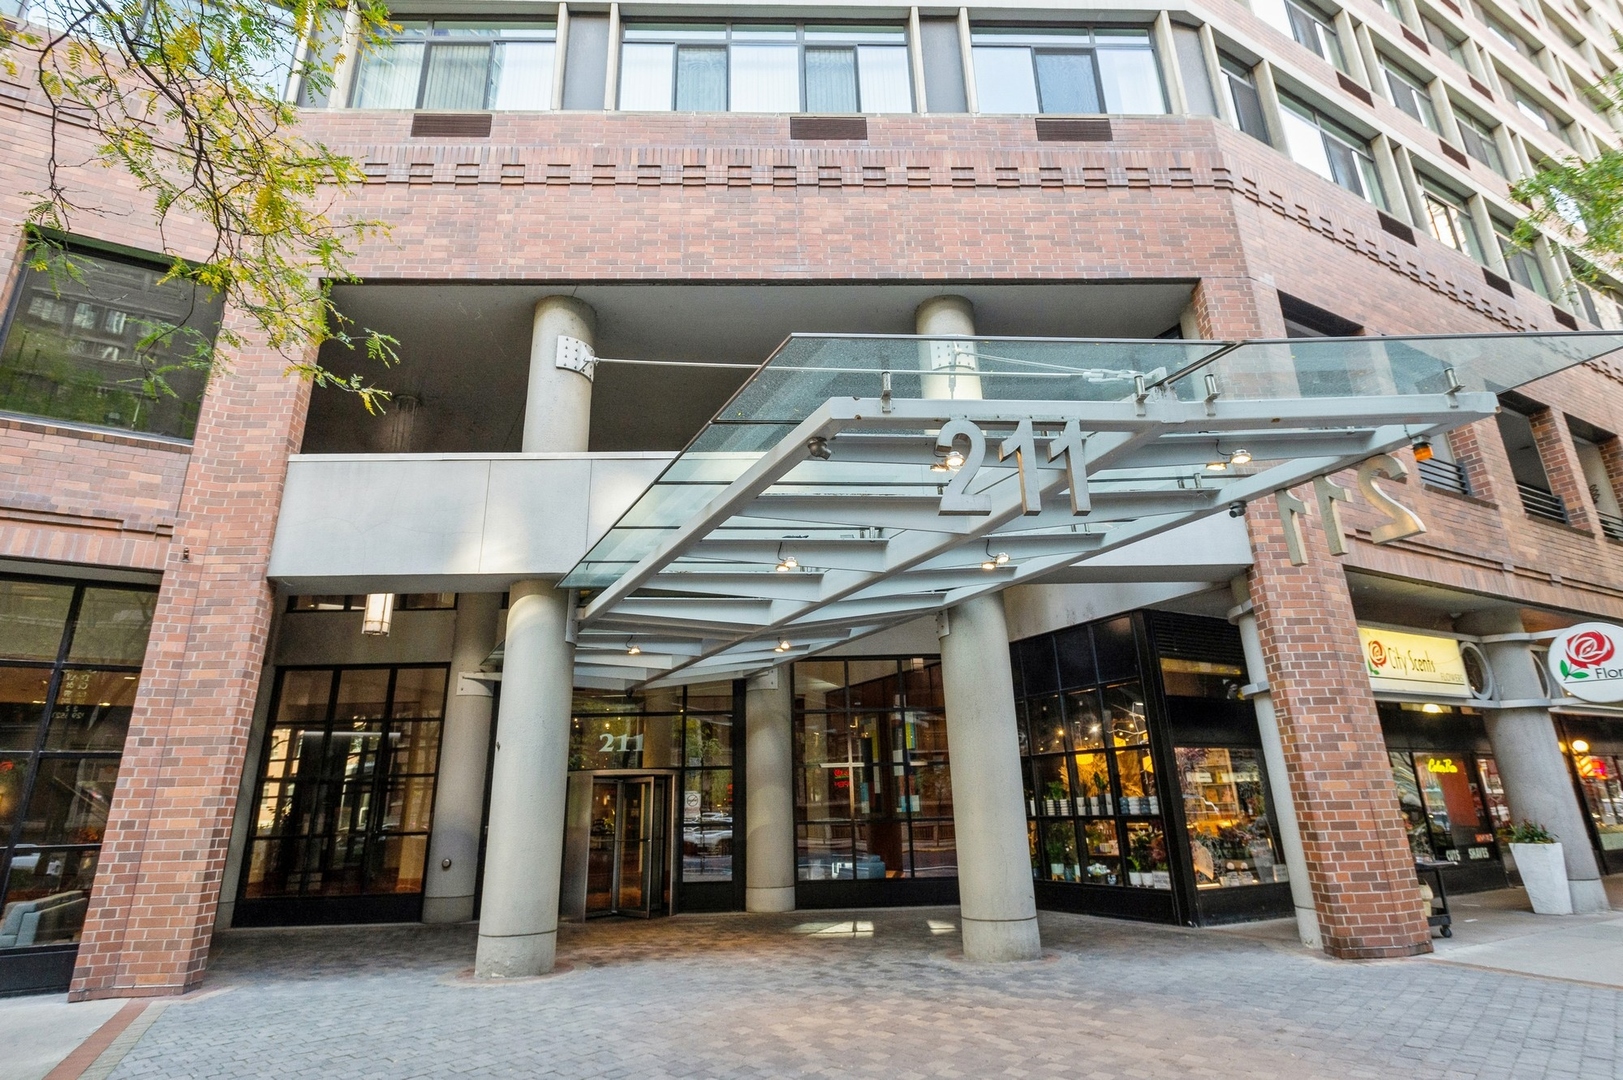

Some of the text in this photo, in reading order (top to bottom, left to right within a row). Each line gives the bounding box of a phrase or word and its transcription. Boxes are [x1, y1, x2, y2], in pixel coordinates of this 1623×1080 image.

[935, 419, 1091, 516] 211
[1387, 646, 1436, 676] City Scents
[1440, 672, 1464, 683] FLOWERS
[599, 733, 644, 752] 211
[1468, 847, 1490, 860] SHAVES
